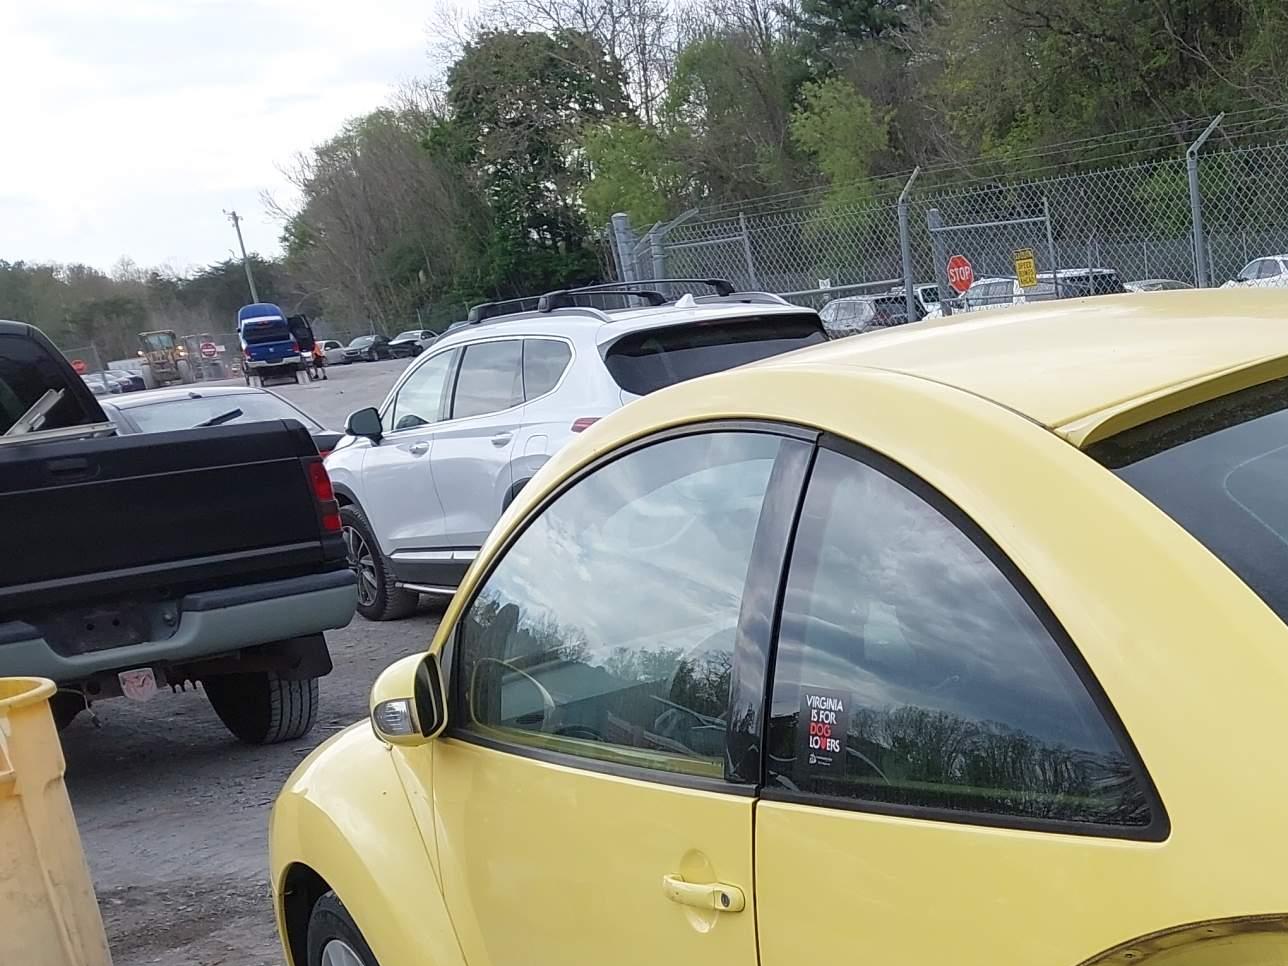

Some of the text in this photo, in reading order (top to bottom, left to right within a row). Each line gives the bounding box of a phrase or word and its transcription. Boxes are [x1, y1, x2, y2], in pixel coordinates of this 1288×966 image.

[950, 265, 970, 282] STOP
[806, 694, 844, 712] VIRGINIA
[811, 710, 837, 724] IS FOR
[810, 723, 832, 737] DOG
[809, 736, 840, 752] LOVERS
